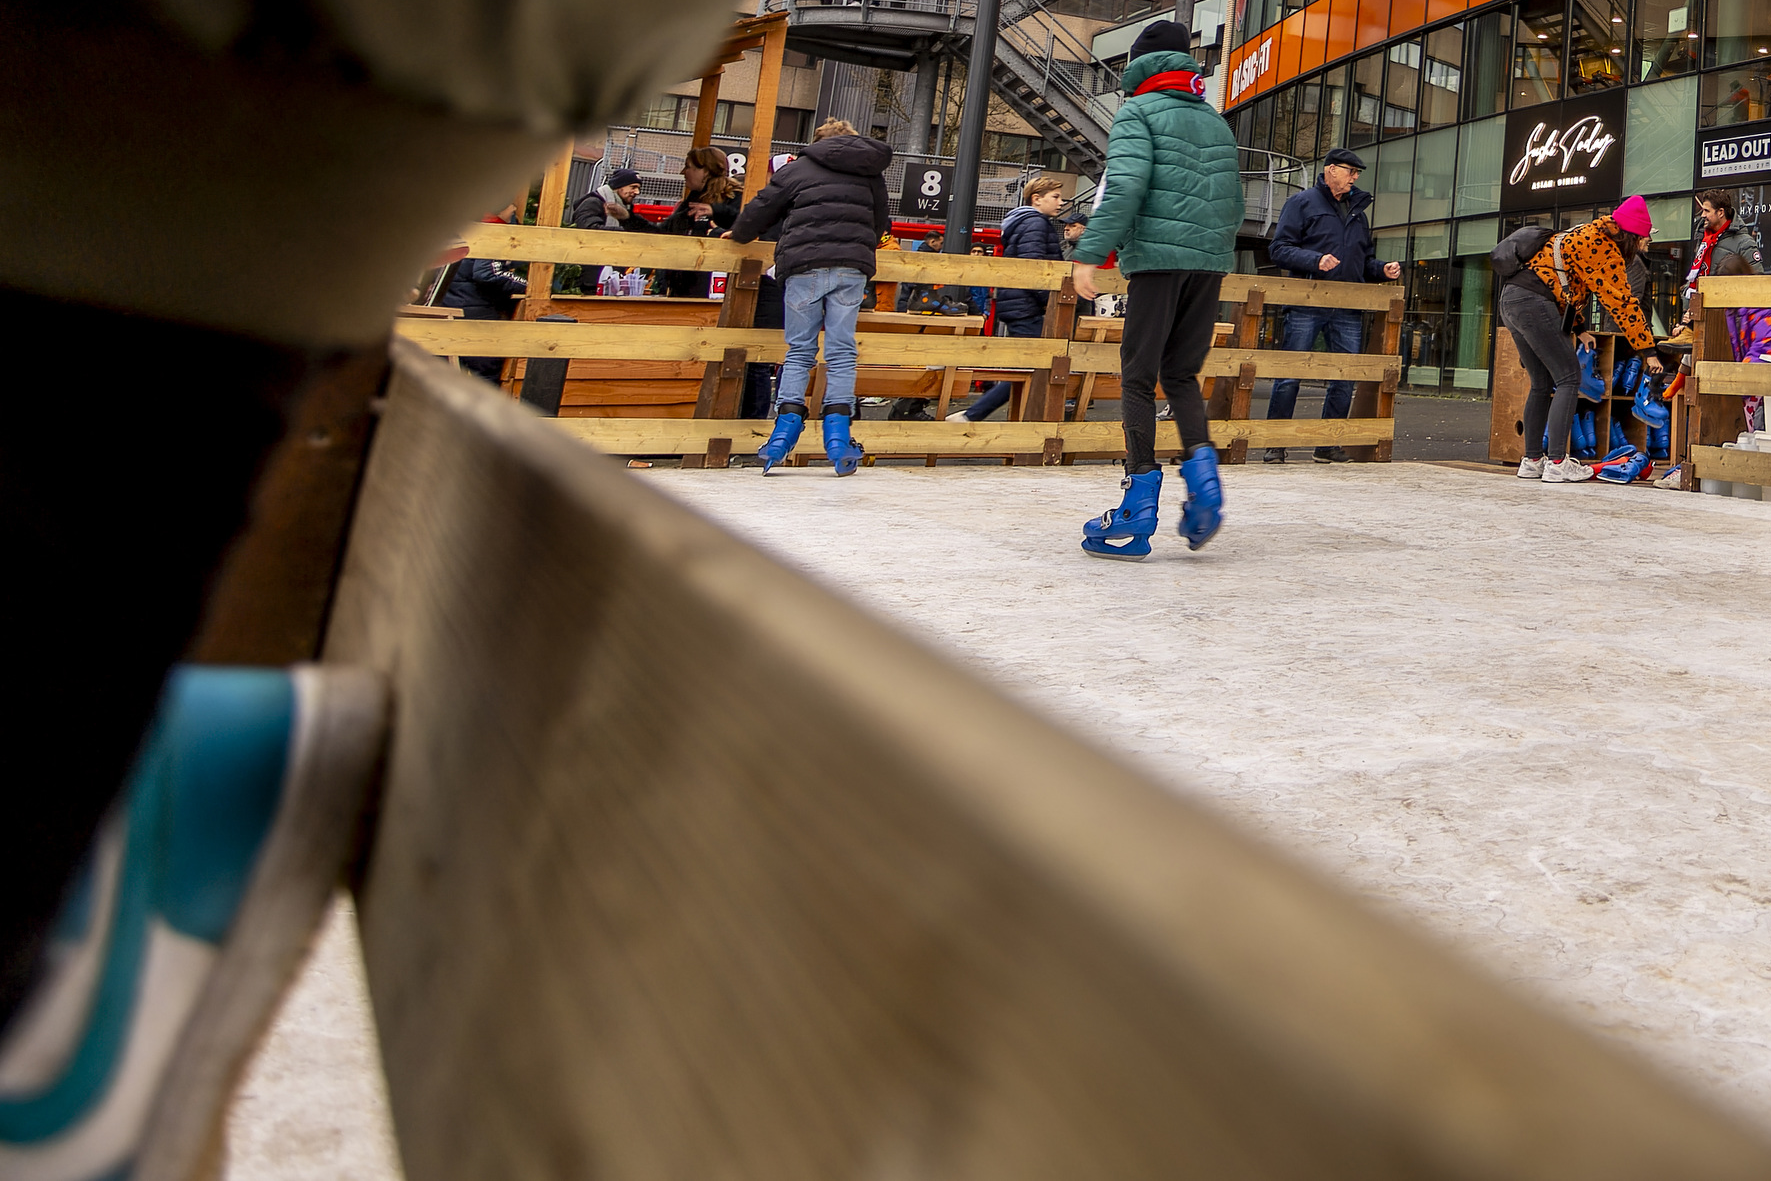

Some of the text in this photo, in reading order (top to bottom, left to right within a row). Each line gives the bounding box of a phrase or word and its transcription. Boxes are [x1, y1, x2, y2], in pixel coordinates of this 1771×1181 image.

[1559, 116, 1616, 173] Today
[1704, 138, 1771, 163] LEAD OUT
[1704, 164, 1751, 175] performance
[921, 170, 942, 196] 8
[917, 198, 940, 210] W-Z
